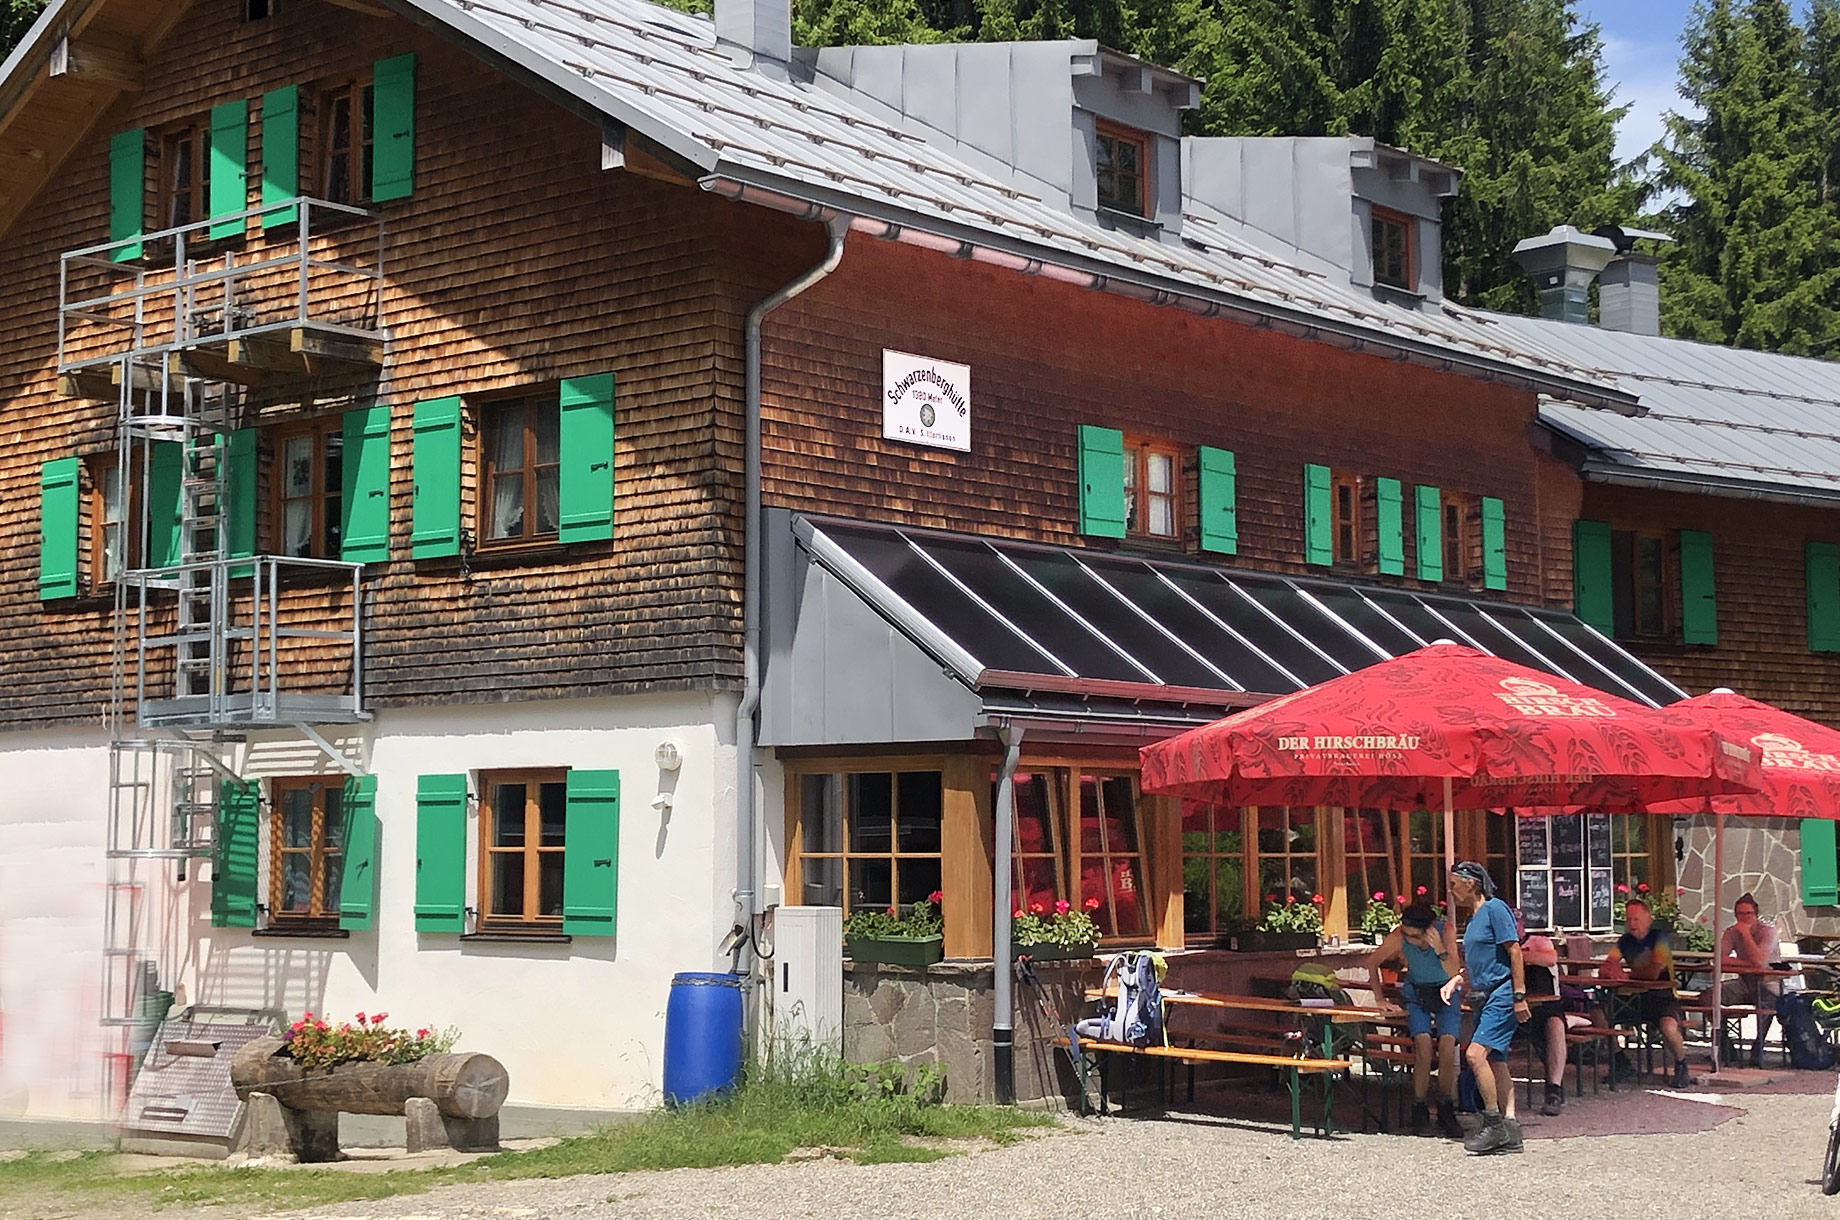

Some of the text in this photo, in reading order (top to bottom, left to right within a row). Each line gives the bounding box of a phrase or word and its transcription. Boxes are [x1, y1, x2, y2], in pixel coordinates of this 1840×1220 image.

[887, 366, 967, 417] Schwarzenberghütte
[1496, 695, 1605, 706] HIRSCH
[1278, 734, 1420, 750] DER HIRSCHBRÄU
